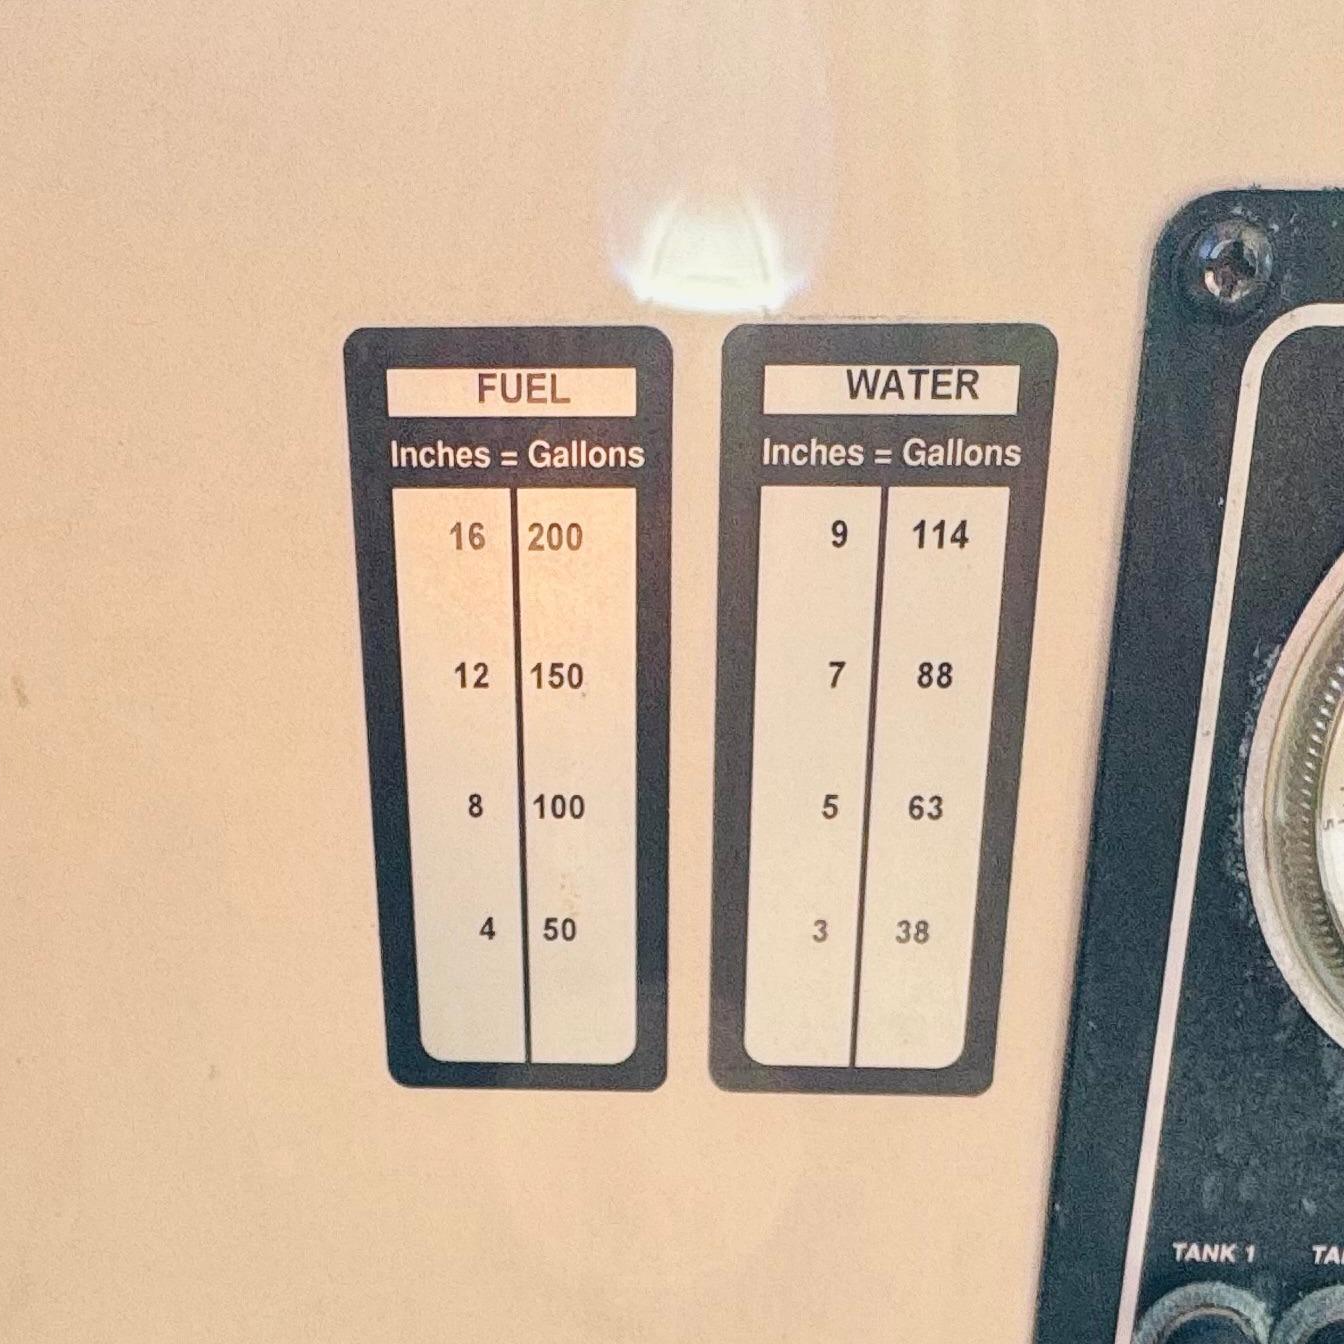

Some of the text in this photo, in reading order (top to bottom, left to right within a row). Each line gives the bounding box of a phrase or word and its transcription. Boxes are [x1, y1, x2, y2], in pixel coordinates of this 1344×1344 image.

[478, 372, 571, 404] FUEL
[847, 368, 980, 400] WATER
[390, 439, 491, 469] Inches
[528, 439, 645, 469] Gallons
[762, 436, 864, 466] Inches
[902, 437, 1022, 467] Gallons
[449, 522, 486, 551] 16
[527, 521, 584, 553] 200
[831, 520, 849, 549] 9
[912, 520, 970, 550] 114
[454, 662, 490, 690] 12
[530, 662, 585, 691] 150
[828, 662, 846, 689] 7
[917, 662, 954, 690] 88
[468, 793, 485, 820] 8
[532, 793, 586, 821] 100
[822, 794, 840, 822] 5
[908, 794, 944, 822] 63
[480, 917, 497, 941] 4
[543, 917, 578, 942] 50
[812, 918, 829, 944] 3
[895, 919, 931, 946] 38
[1173, 1241, 1256, 1263] TANK 1
